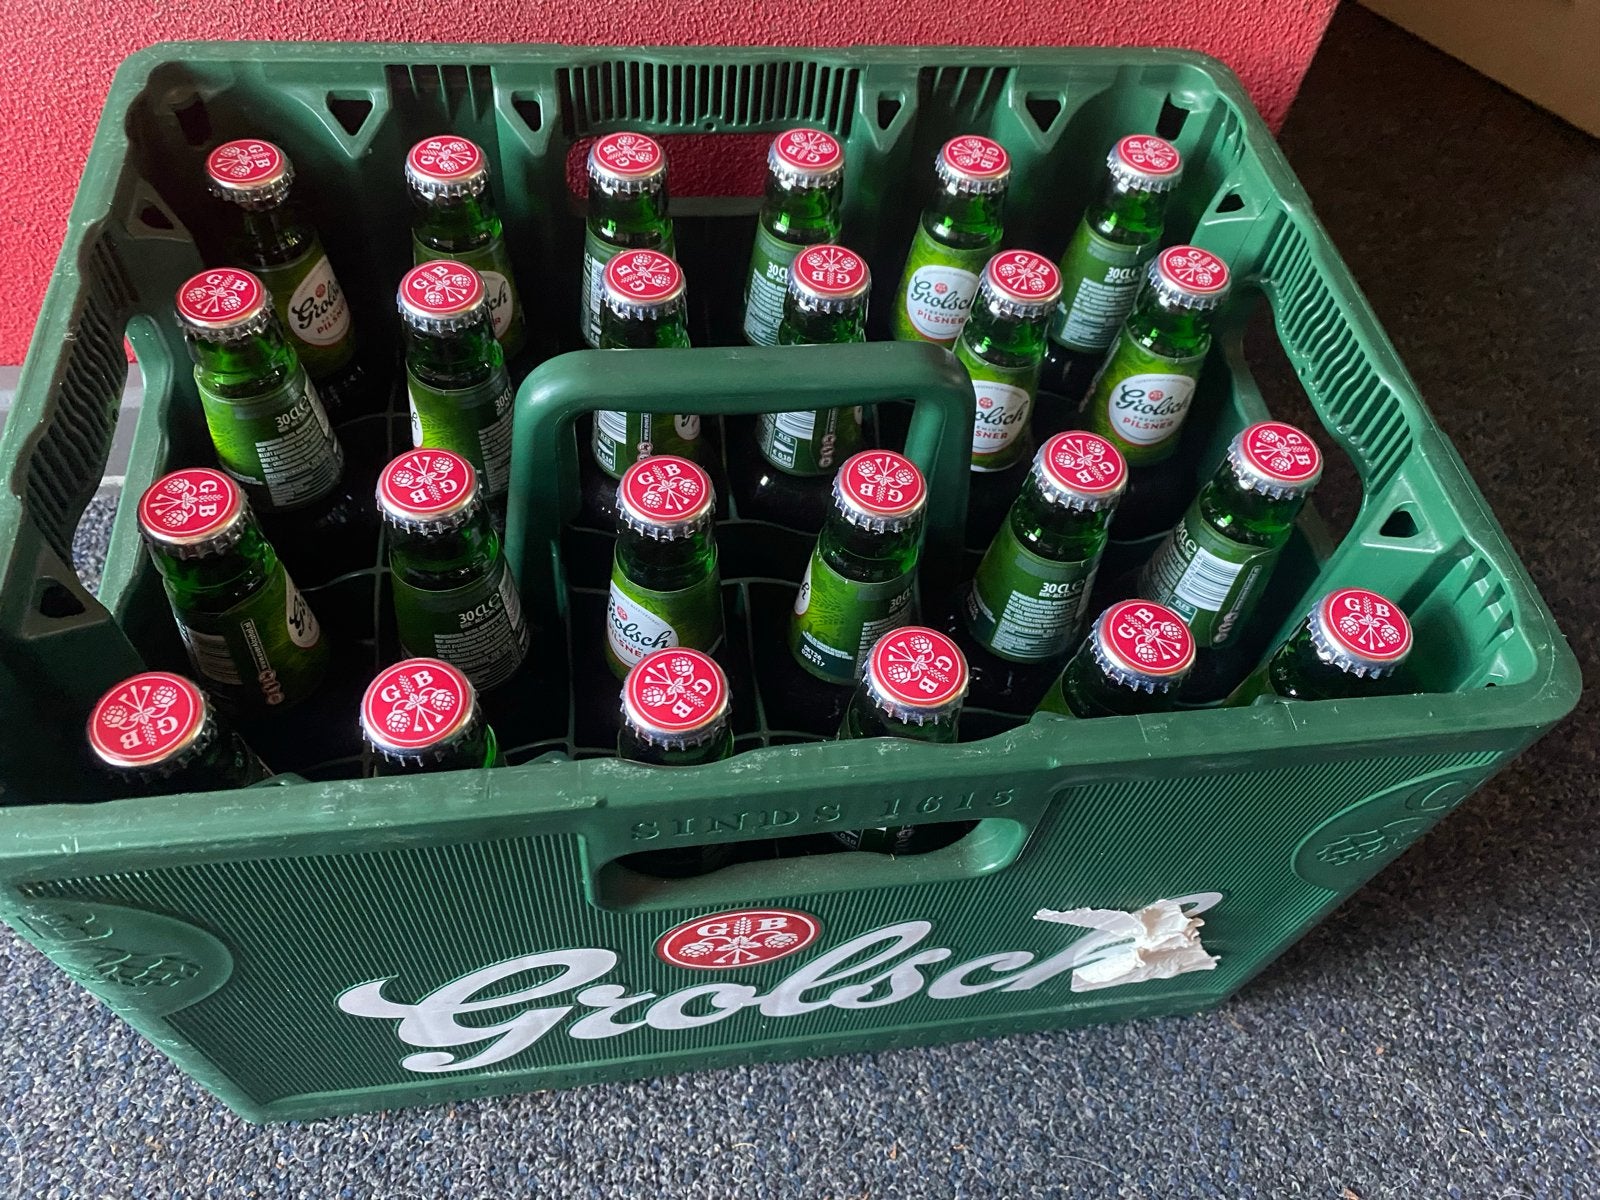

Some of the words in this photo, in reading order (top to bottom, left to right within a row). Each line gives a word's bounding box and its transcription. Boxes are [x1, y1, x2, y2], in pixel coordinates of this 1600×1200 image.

[911, 276, 971, 311] Grolsc
[291, 280, 340, 330] Grols
[974, 400, 1029, 426] olsch
[975, 430, 1008, 440] SNER
[1345, 598, 1361, 611] G
[1374, 603, 1390, 617] B
[1118, 623, 1136, 638] G
[1135, 609, 1153, 623] B
[934, 656, 952, 672] G
[381, 685, 401, 702] G
[412, 671, 433, 688] B
[692, 679, 711, 695] G
[919, 676, 938, 693] B
[672, 700, 693, 718] B
[157, 717, 178, 735] G
[120, 730, 142, 749] B
[630, 801, 841, 841] SINDS
[878, 788, 1015, 821] 1615
